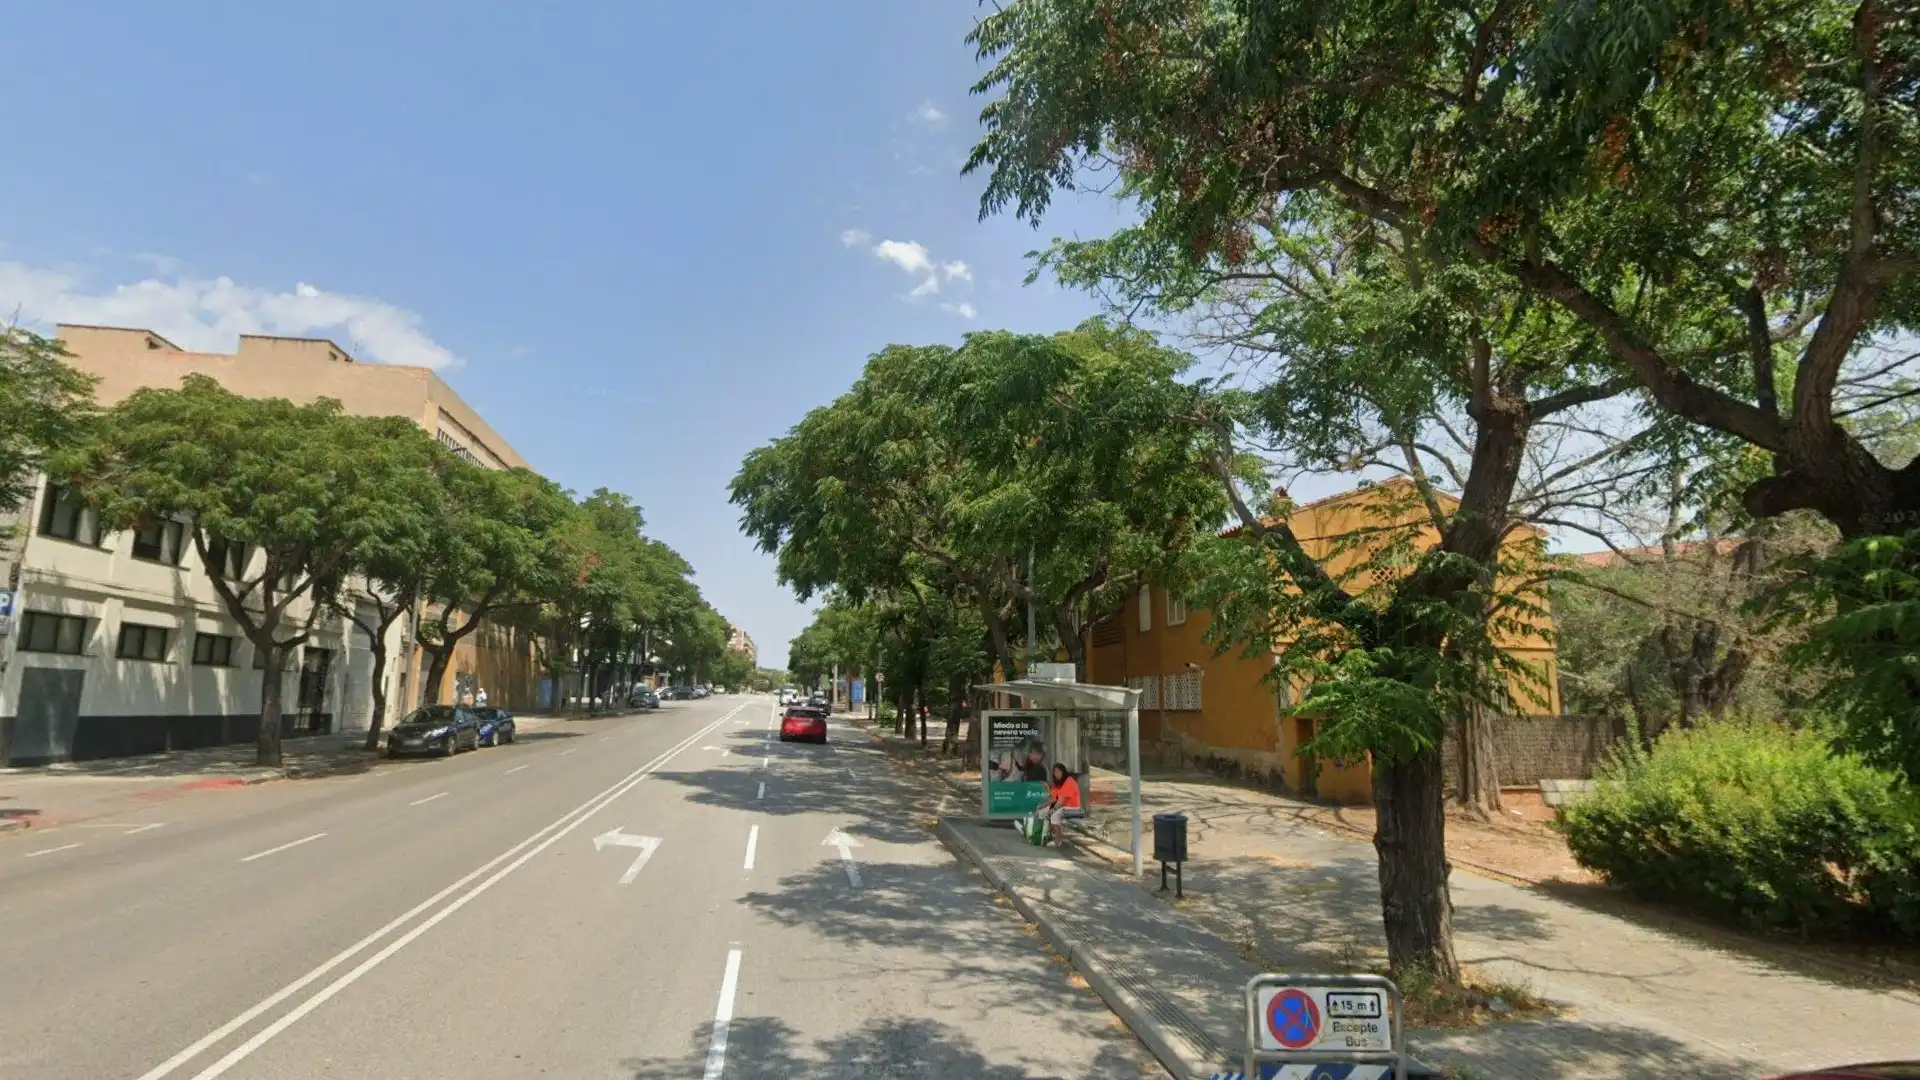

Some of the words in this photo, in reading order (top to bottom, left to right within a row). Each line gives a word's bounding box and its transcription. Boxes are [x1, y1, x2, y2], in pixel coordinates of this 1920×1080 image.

[993, 721, 1015, 729] Miedo
[1021, 721, 1029, 729] la
[1340, 1000, 1353, 1011] 15
[1357, 1002, 1367, 1010] m
[1333, 1021, 1378, 1034] Excepte
[1345, 1035, 1368, 1047] Bus
